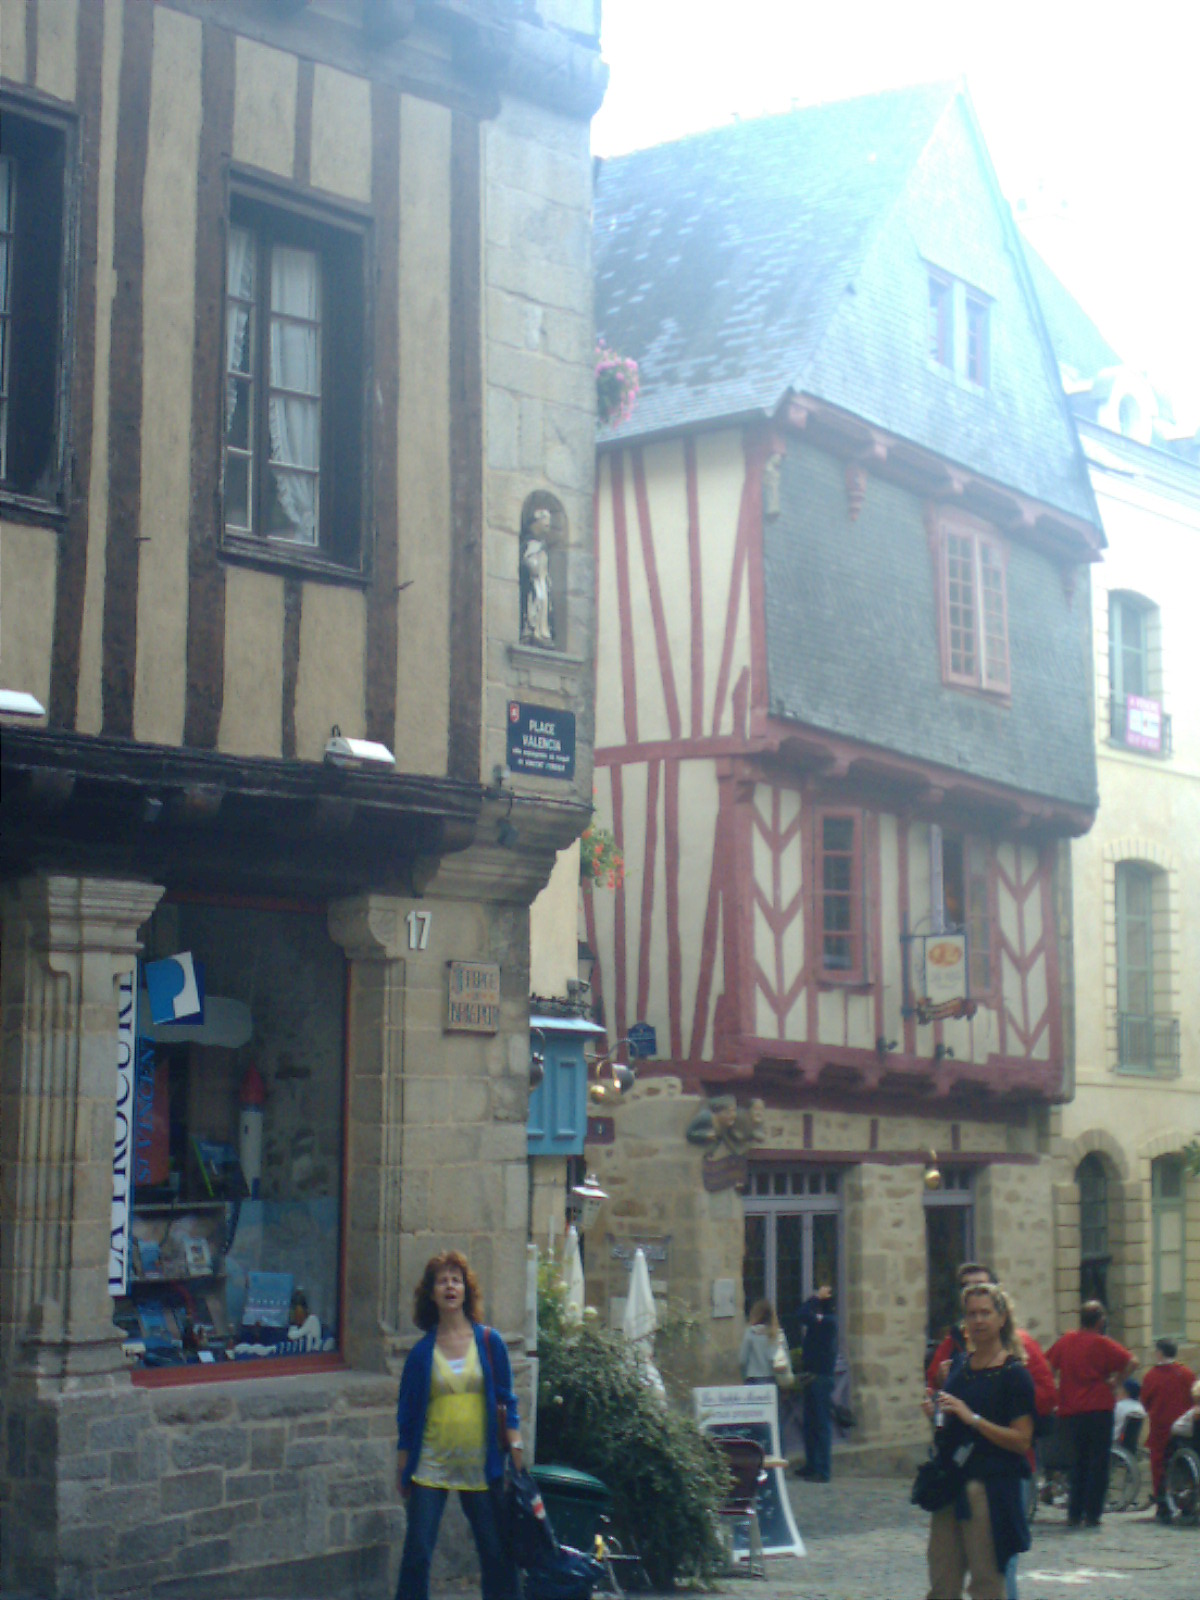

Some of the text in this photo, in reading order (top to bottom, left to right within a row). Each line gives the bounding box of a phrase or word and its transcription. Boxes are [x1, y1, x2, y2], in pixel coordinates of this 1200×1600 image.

[529, 719, 556, 736] PLACE
[522, 734, 562, 752] VALENCIA
[407, 911, 432, 950] 17
